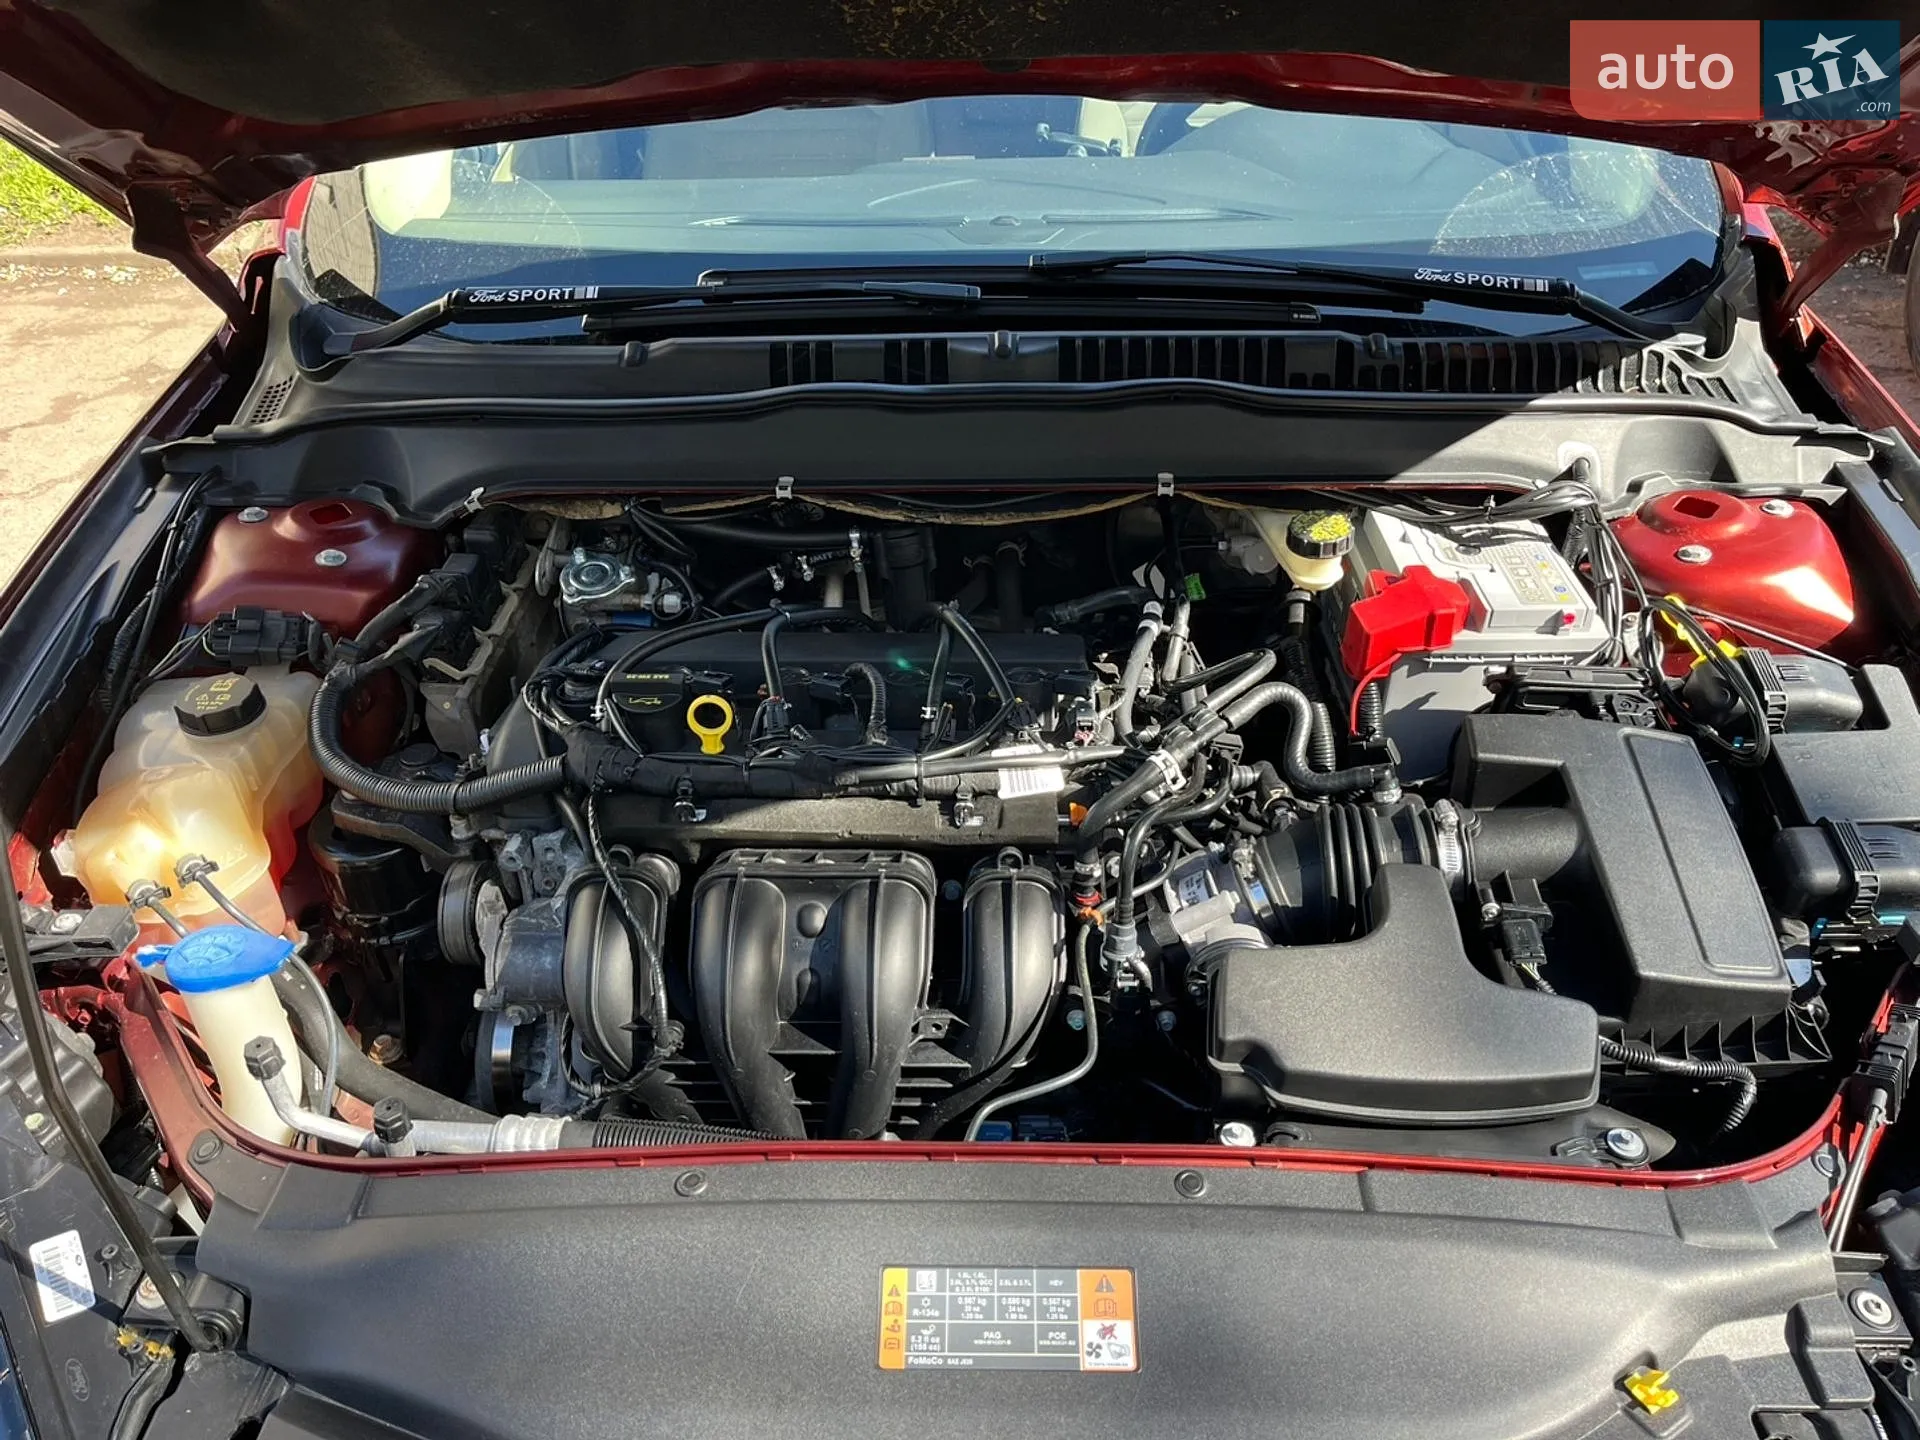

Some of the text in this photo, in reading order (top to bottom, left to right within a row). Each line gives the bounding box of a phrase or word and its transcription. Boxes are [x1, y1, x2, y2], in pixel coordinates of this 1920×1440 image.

[1414, 267, 1521, 290] Ford SPORT
[469, 287, 574, 303] Ford SPORT
[907, 1356, 943, 1365] FoMoCo
